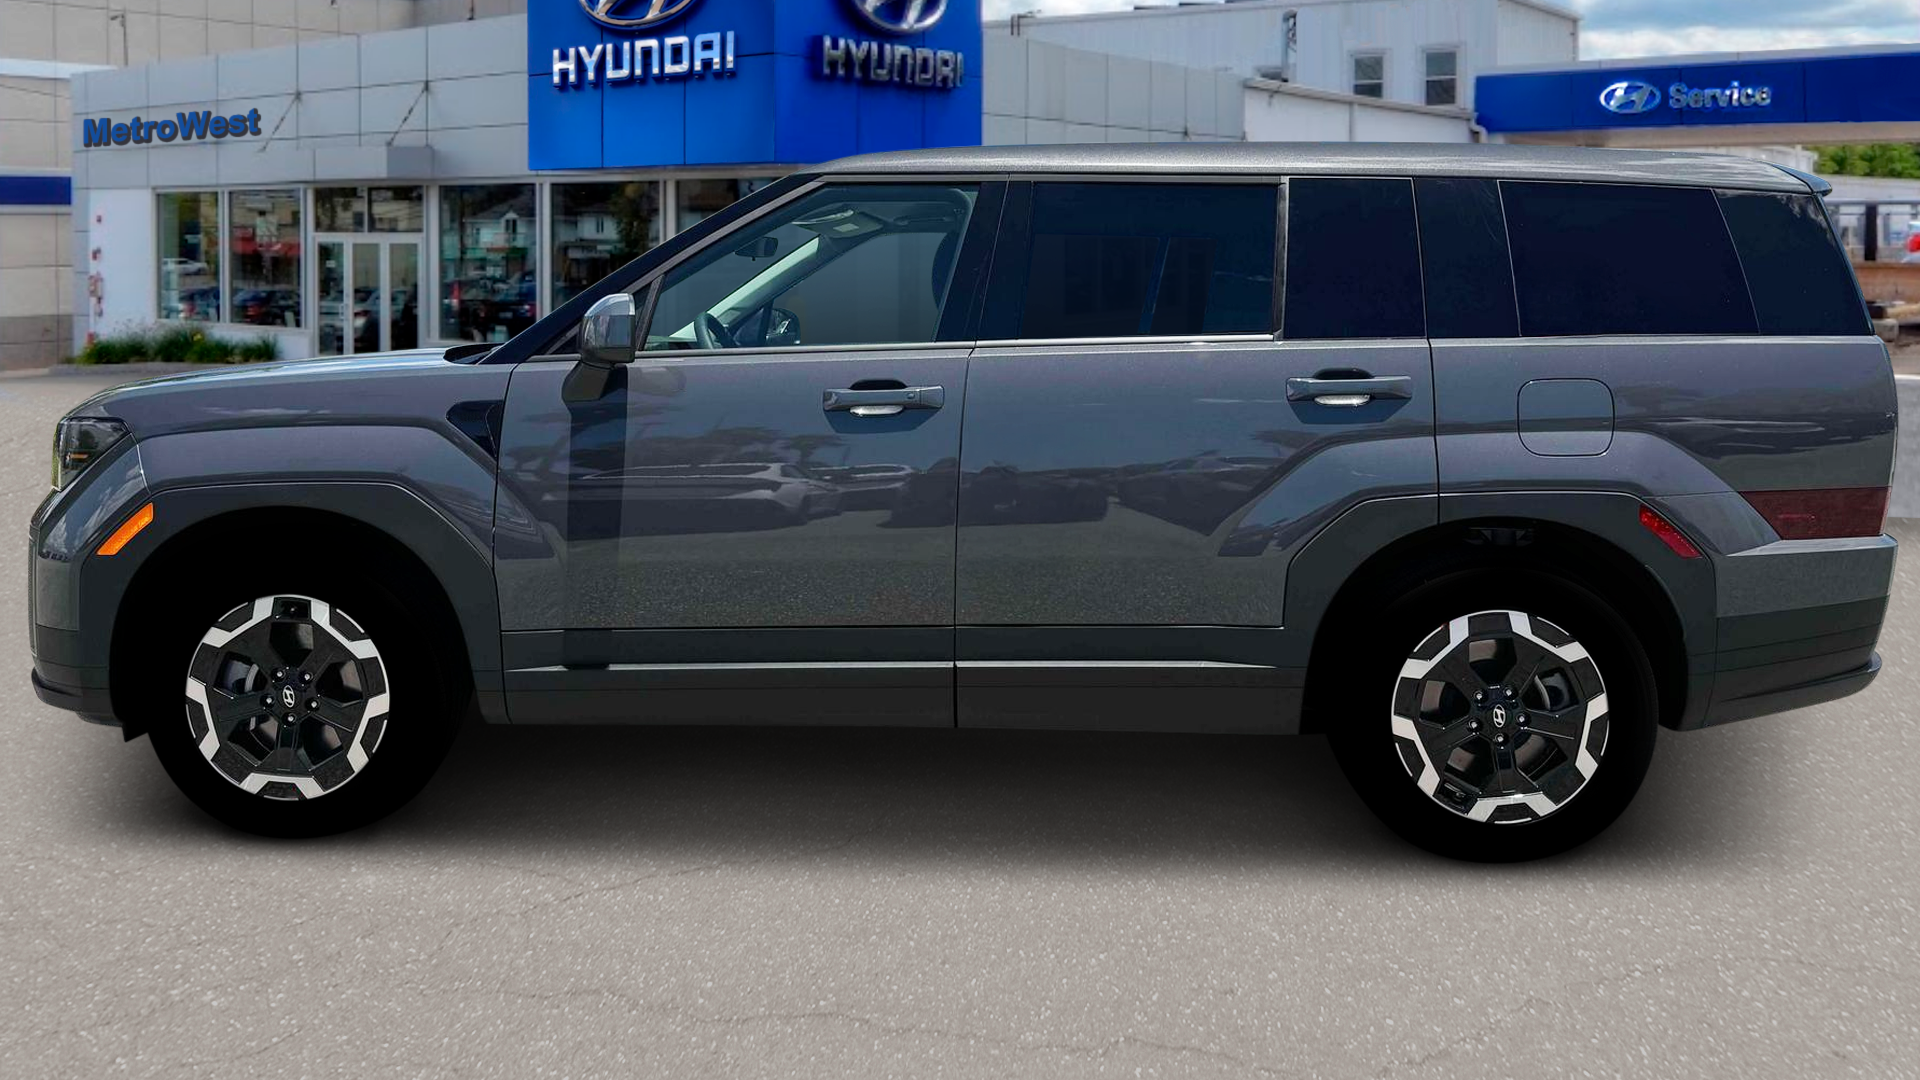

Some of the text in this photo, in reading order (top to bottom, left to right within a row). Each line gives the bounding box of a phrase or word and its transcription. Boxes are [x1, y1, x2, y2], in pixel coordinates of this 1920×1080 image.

[553, 30, 735, 86] HYUNDAI
[823, 34, 965, 88] HYUNDAI
[1669, 81, 1772, 109] Service
[83, 107, 262, 148] MetroWest
